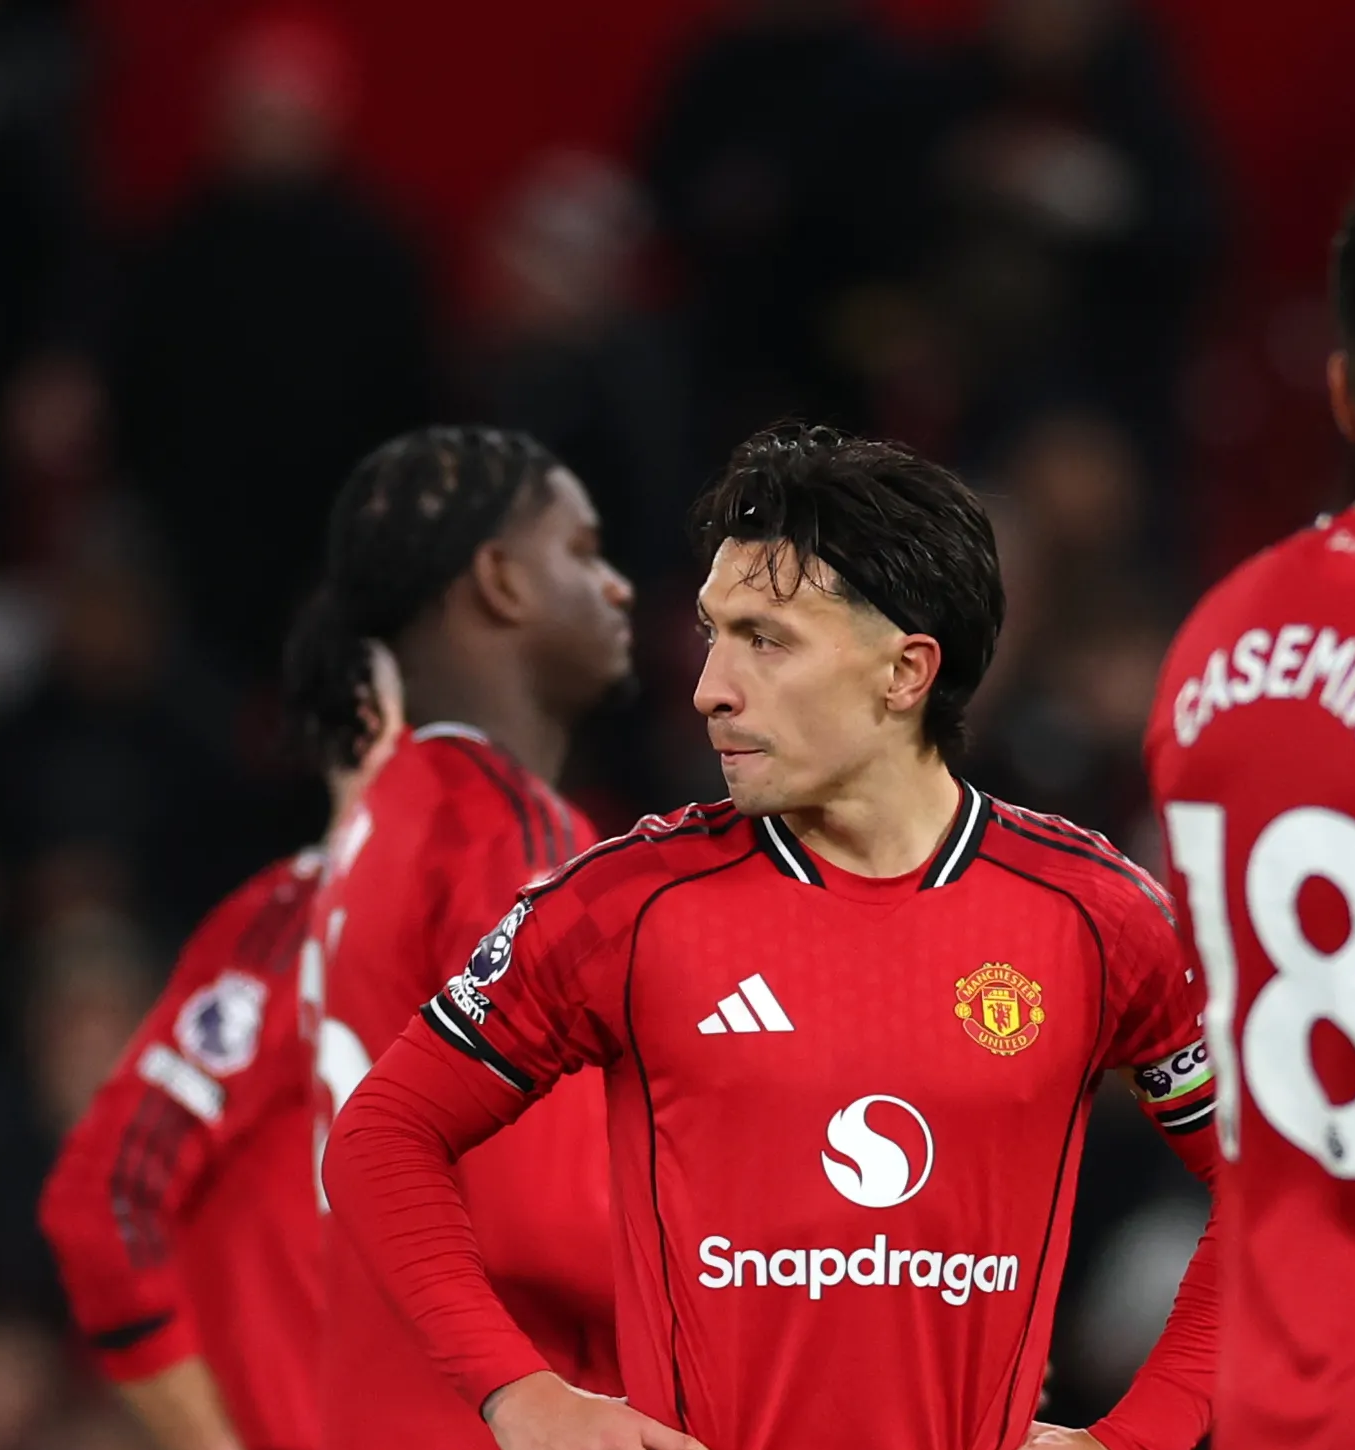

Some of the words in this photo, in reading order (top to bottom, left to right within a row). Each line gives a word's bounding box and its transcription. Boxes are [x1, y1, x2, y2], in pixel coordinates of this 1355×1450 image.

[962, 969, 1036, 1000] MANCHESTER
[978, 1031, 1027, 1050] UNITED
[698, 1234, 1019, 1306] Snapdragon
